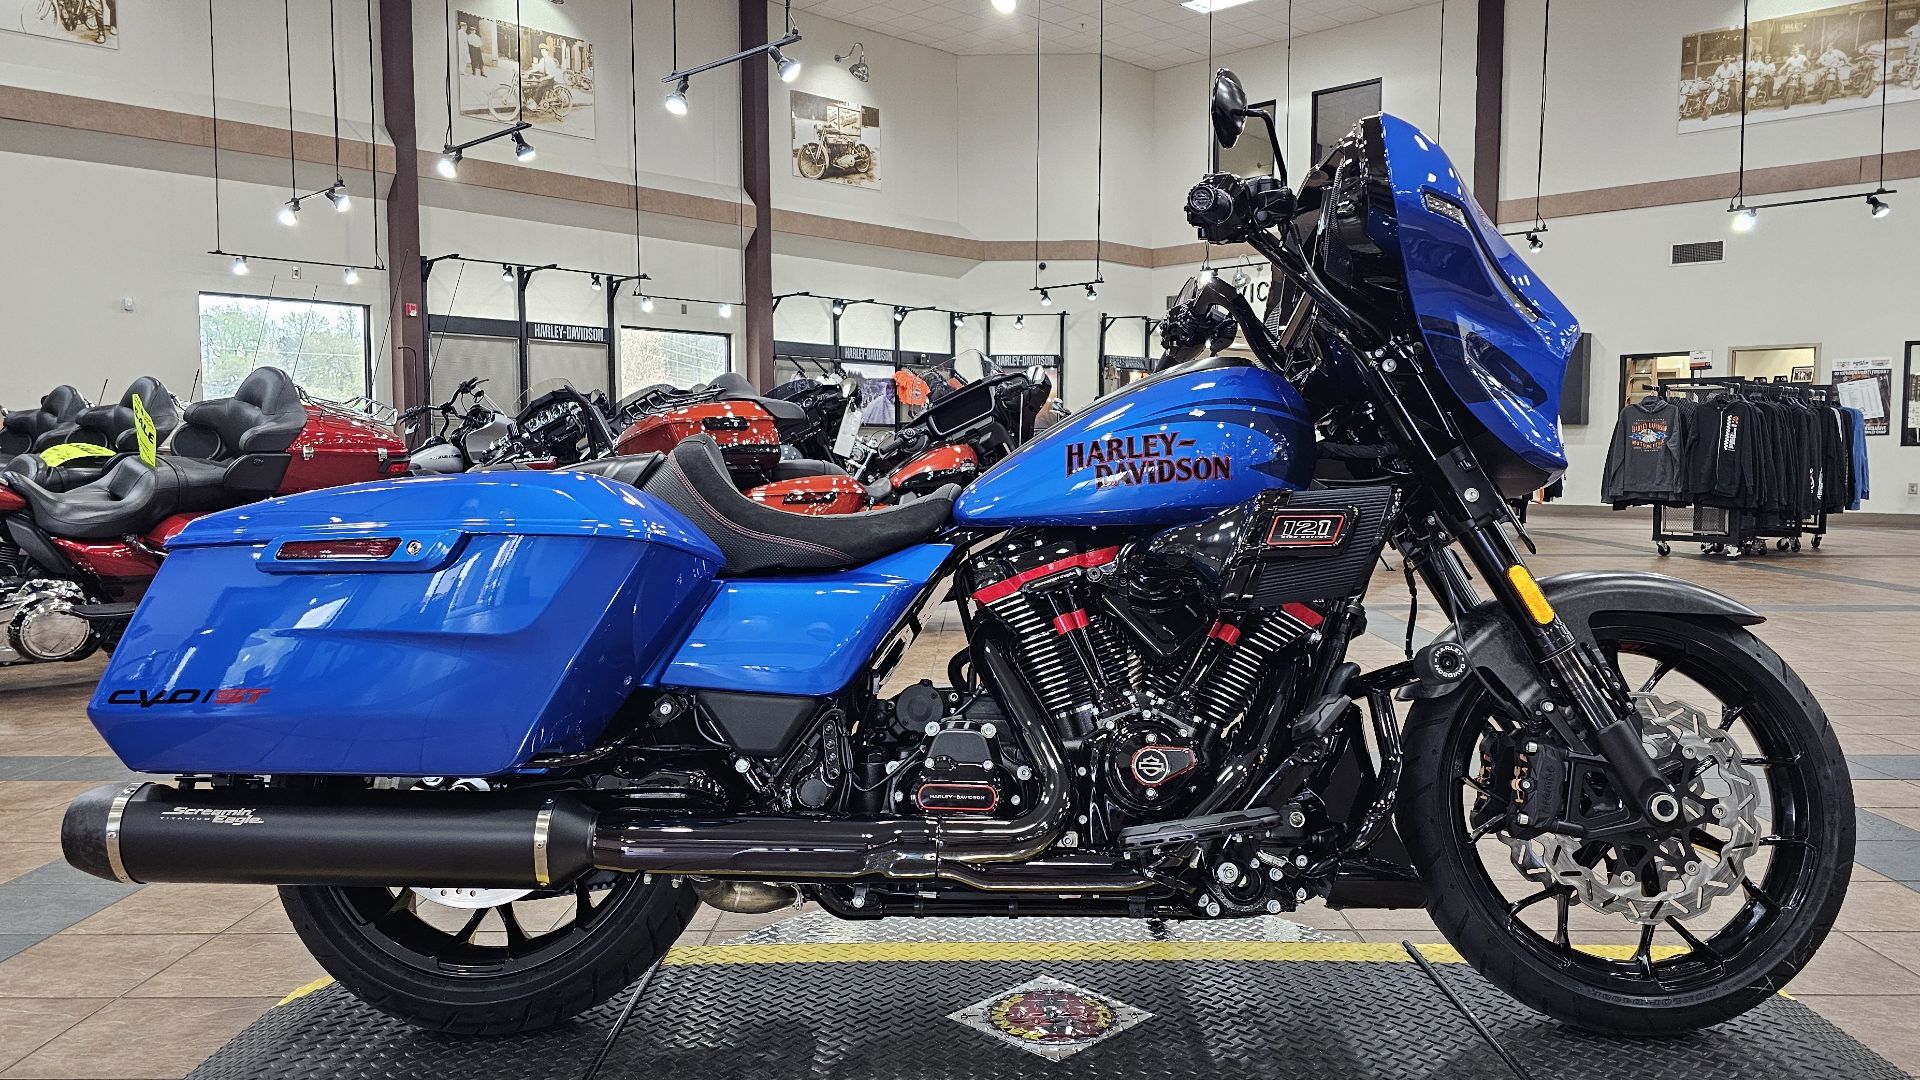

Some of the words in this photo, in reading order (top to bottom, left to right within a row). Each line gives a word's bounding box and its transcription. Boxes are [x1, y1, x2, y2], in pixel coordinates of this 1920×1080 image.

[534, 324, 603, 341] HARLEY-DAVIDSON
[844, 346, 893, 361] HARLEY-DAVIDSON
[996, 355, 1056, 366] HARLEY-DAVIDSON
[1066, 432, 1196, 478] HARLEY-
[1095, 456, 1232, 489] DAVIDSON
[1282, 520, 1331, 536] 121
[1434, 645, 1464, 657] HARLEY
[211, 814, 265, 826] Eagle
